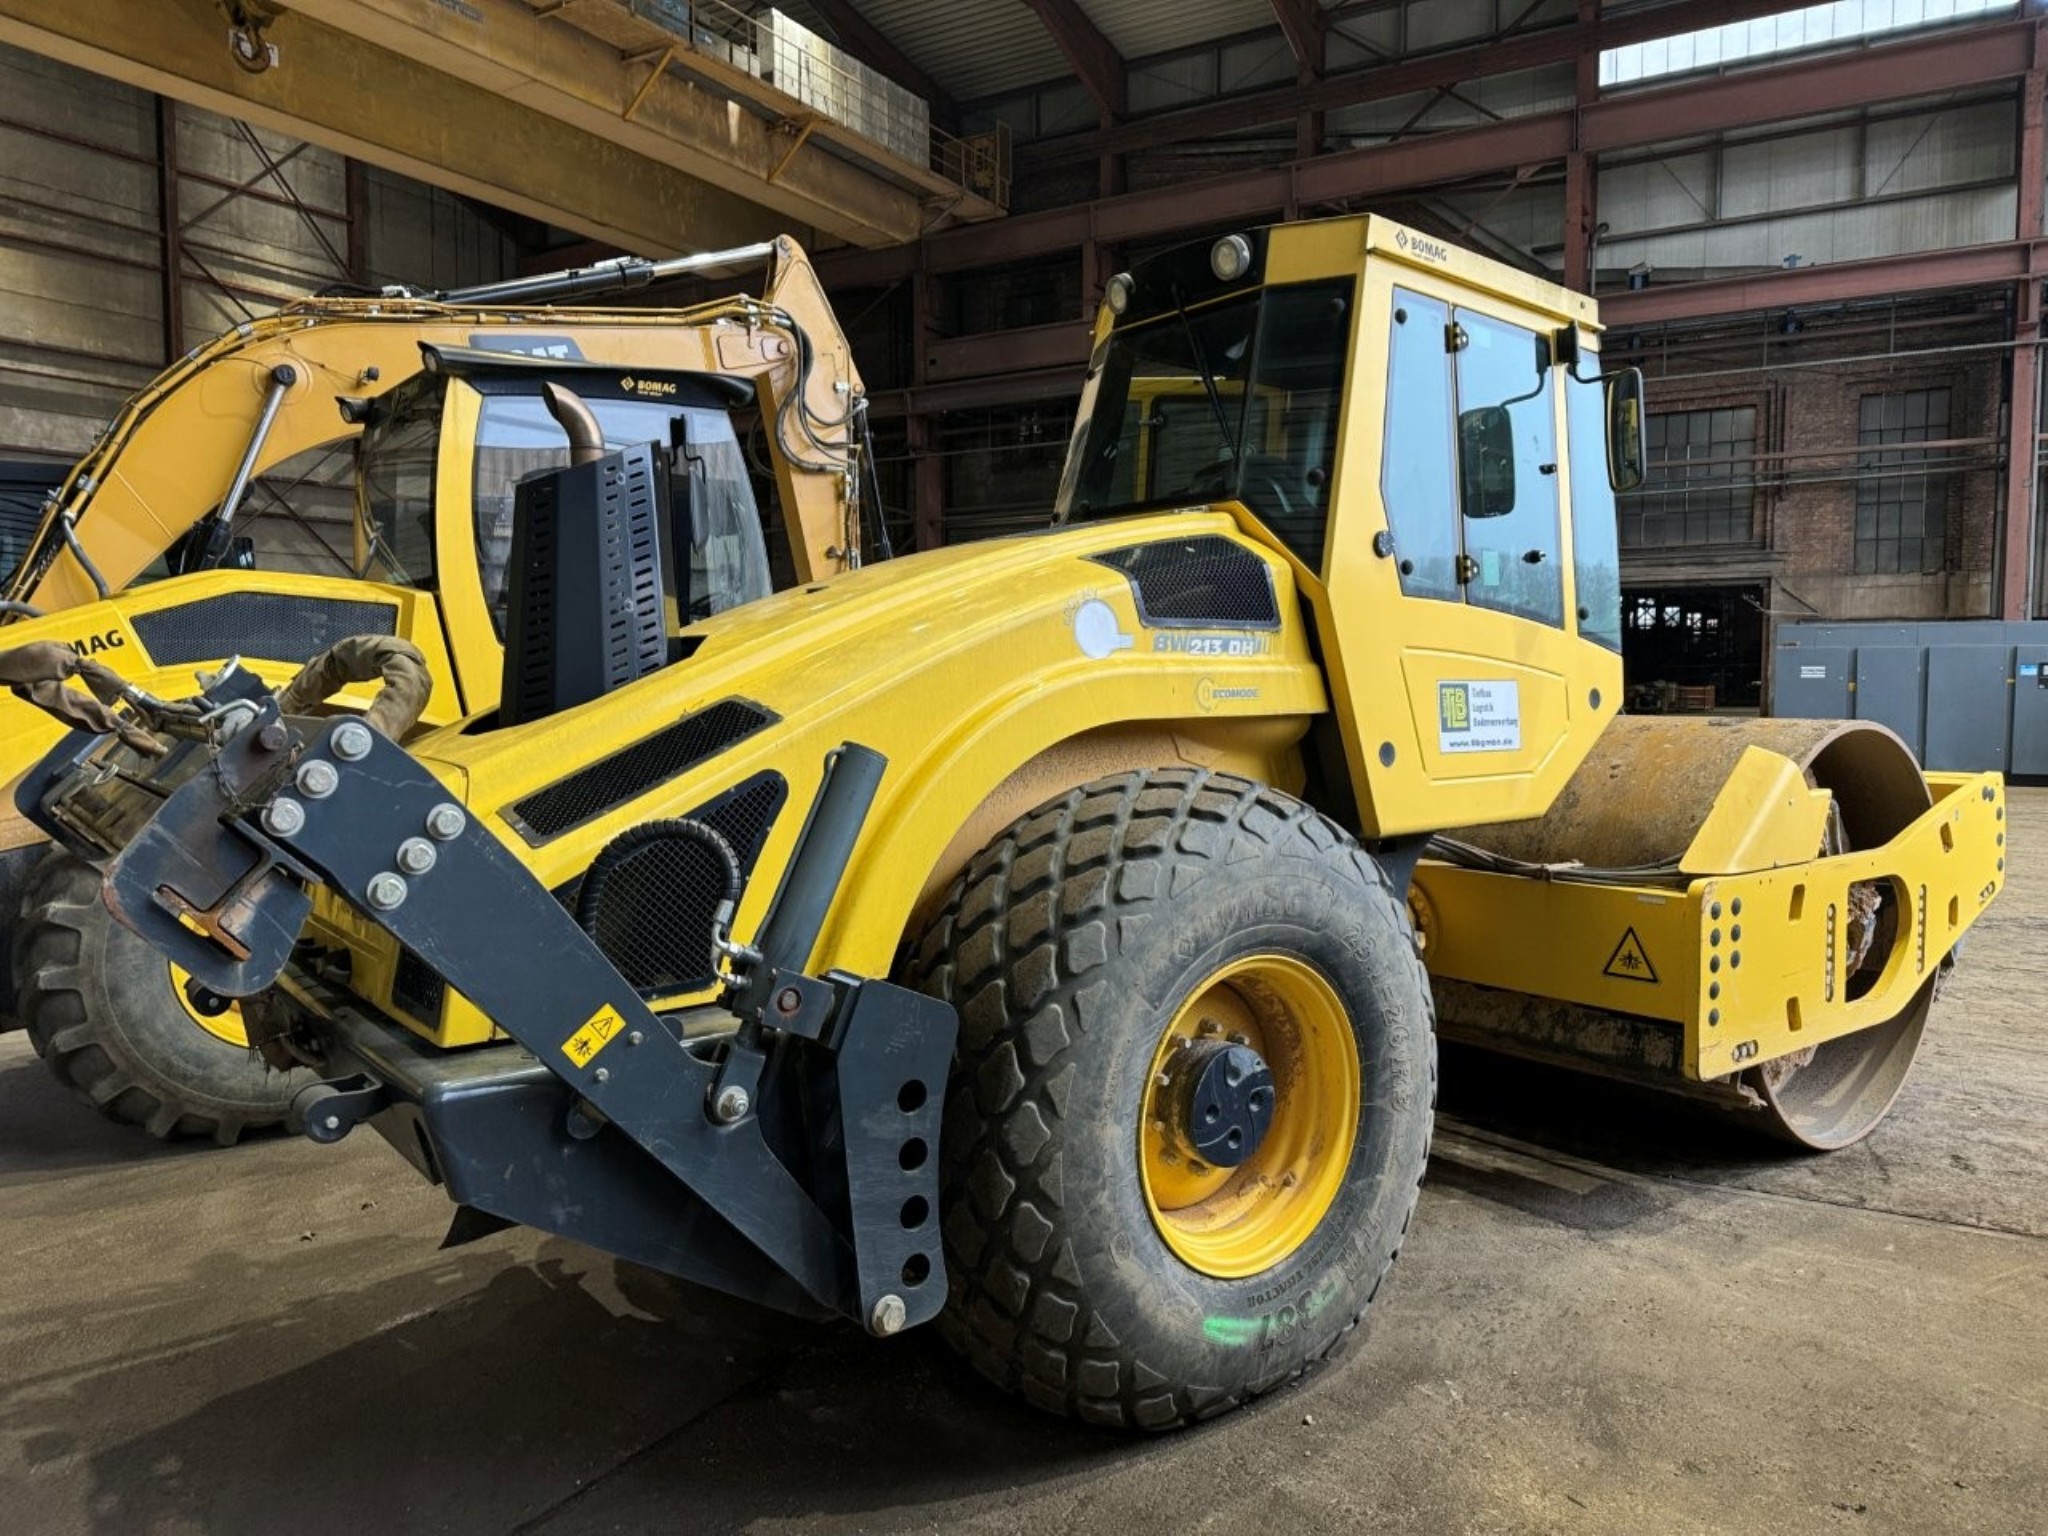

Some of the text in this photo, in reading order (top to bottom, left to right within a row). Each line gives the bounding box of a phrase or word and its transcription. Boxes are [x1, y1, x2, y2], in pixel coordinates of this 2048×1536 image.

[1411, 236, 1447, 262] BOMAG
[511, 344, 569, 359] AT
[637, 380, 677, 394] BOMAG
[67, 629, 125, 657] MAG
[1189, 639, 1223, 656] 213
[1212, 688, 1259, 699] ECOMODE
